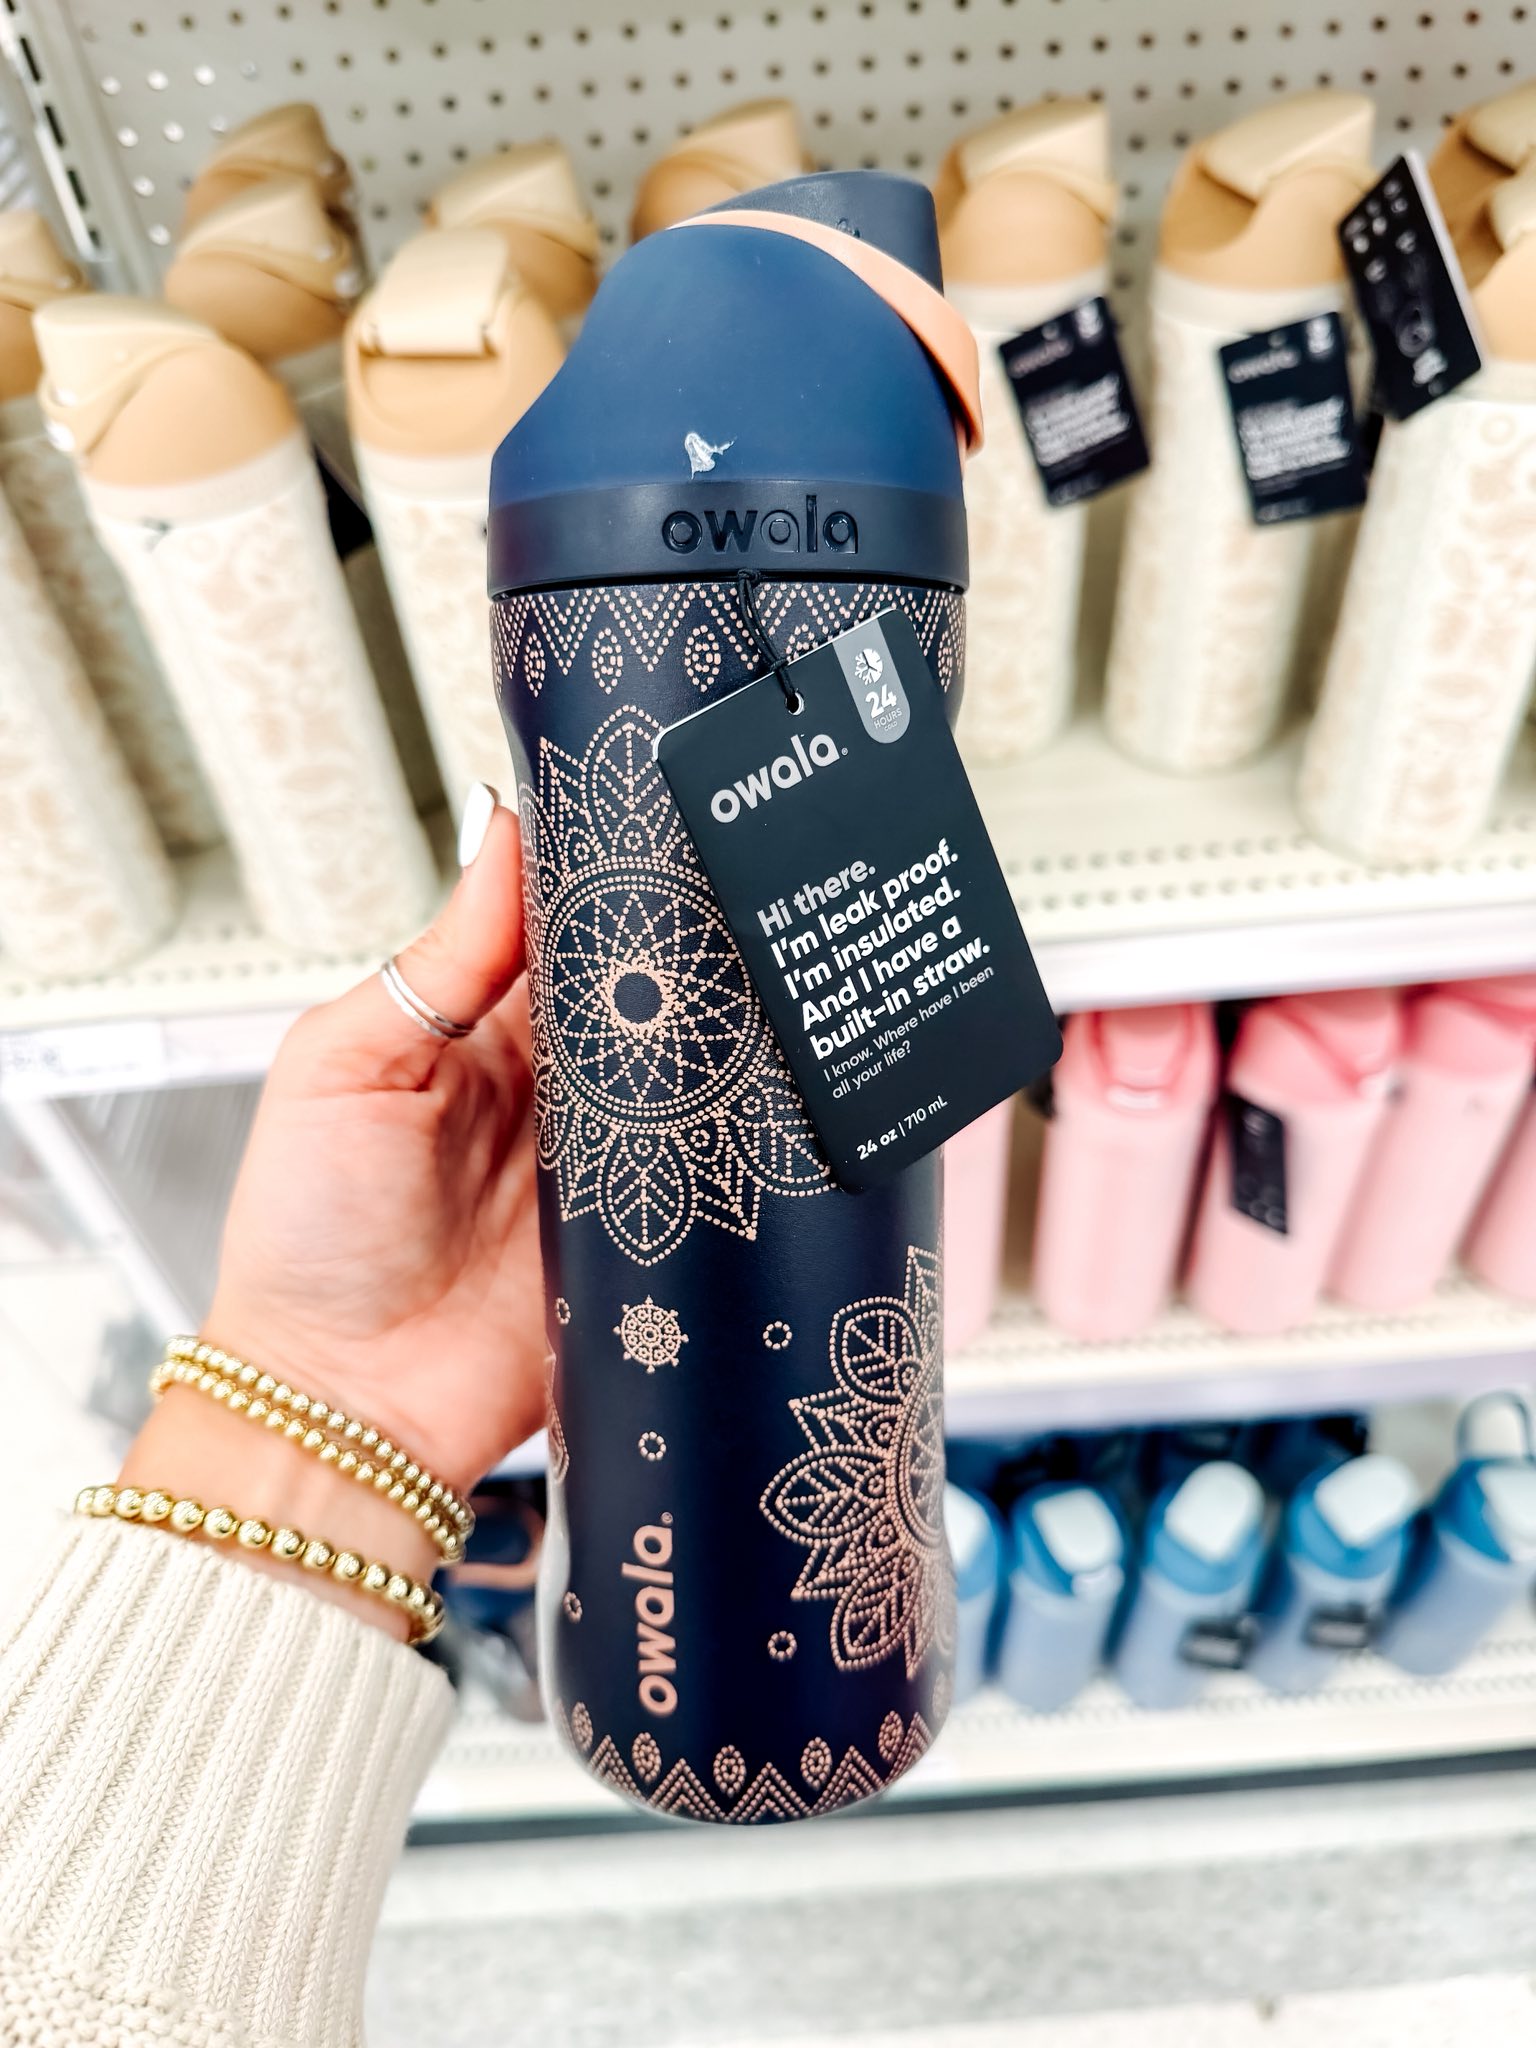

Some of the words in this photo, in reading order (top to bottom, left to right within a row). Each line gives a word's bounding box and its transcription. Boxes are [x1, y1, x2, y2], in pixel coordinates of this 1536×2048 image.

[662, 495, 858, 554] owala
[865, 684, 897, 718] 24
[874, 708, 902, 728] HOURS
[757, 898, 793, 938] Hi
[793, 860, 876, 915] there.
[770, 931, 820, 969] I'm
[818, 889, 882, 941] leak
[881, 838, 958, 910] proof.
[784, 962, 832, 1000] I'm
[831, 876, 961, 972] insulated.
[802, 976, 859, 1032] And
[858, 967, 873, 994] I
[871, 932, 938, 985] have
[942, 915, 962, 940] a
[809, 988, 912, 1061] built-in
[913, 937, 990, 996] straw.
[823, 1069, 831, 1082] I
[831, 1048, 873, 1078] know.
[873, 1017, 918, 1051] Where
[918, 995, 953, 1022] have
[952, 985, 960, 999] I
[959, 966, 994, 995] been
[832, 1079, 852, 1099] all
[852, 1061, 883, 1090] your
[883, 1040, 911, 1067] life?
[857, 1139, 878, 1160] 24
[879, 1128, 898, 1146] oz
[904, 1107, 926, 1130] 710
[927, 1095, 948, 1115] mL
